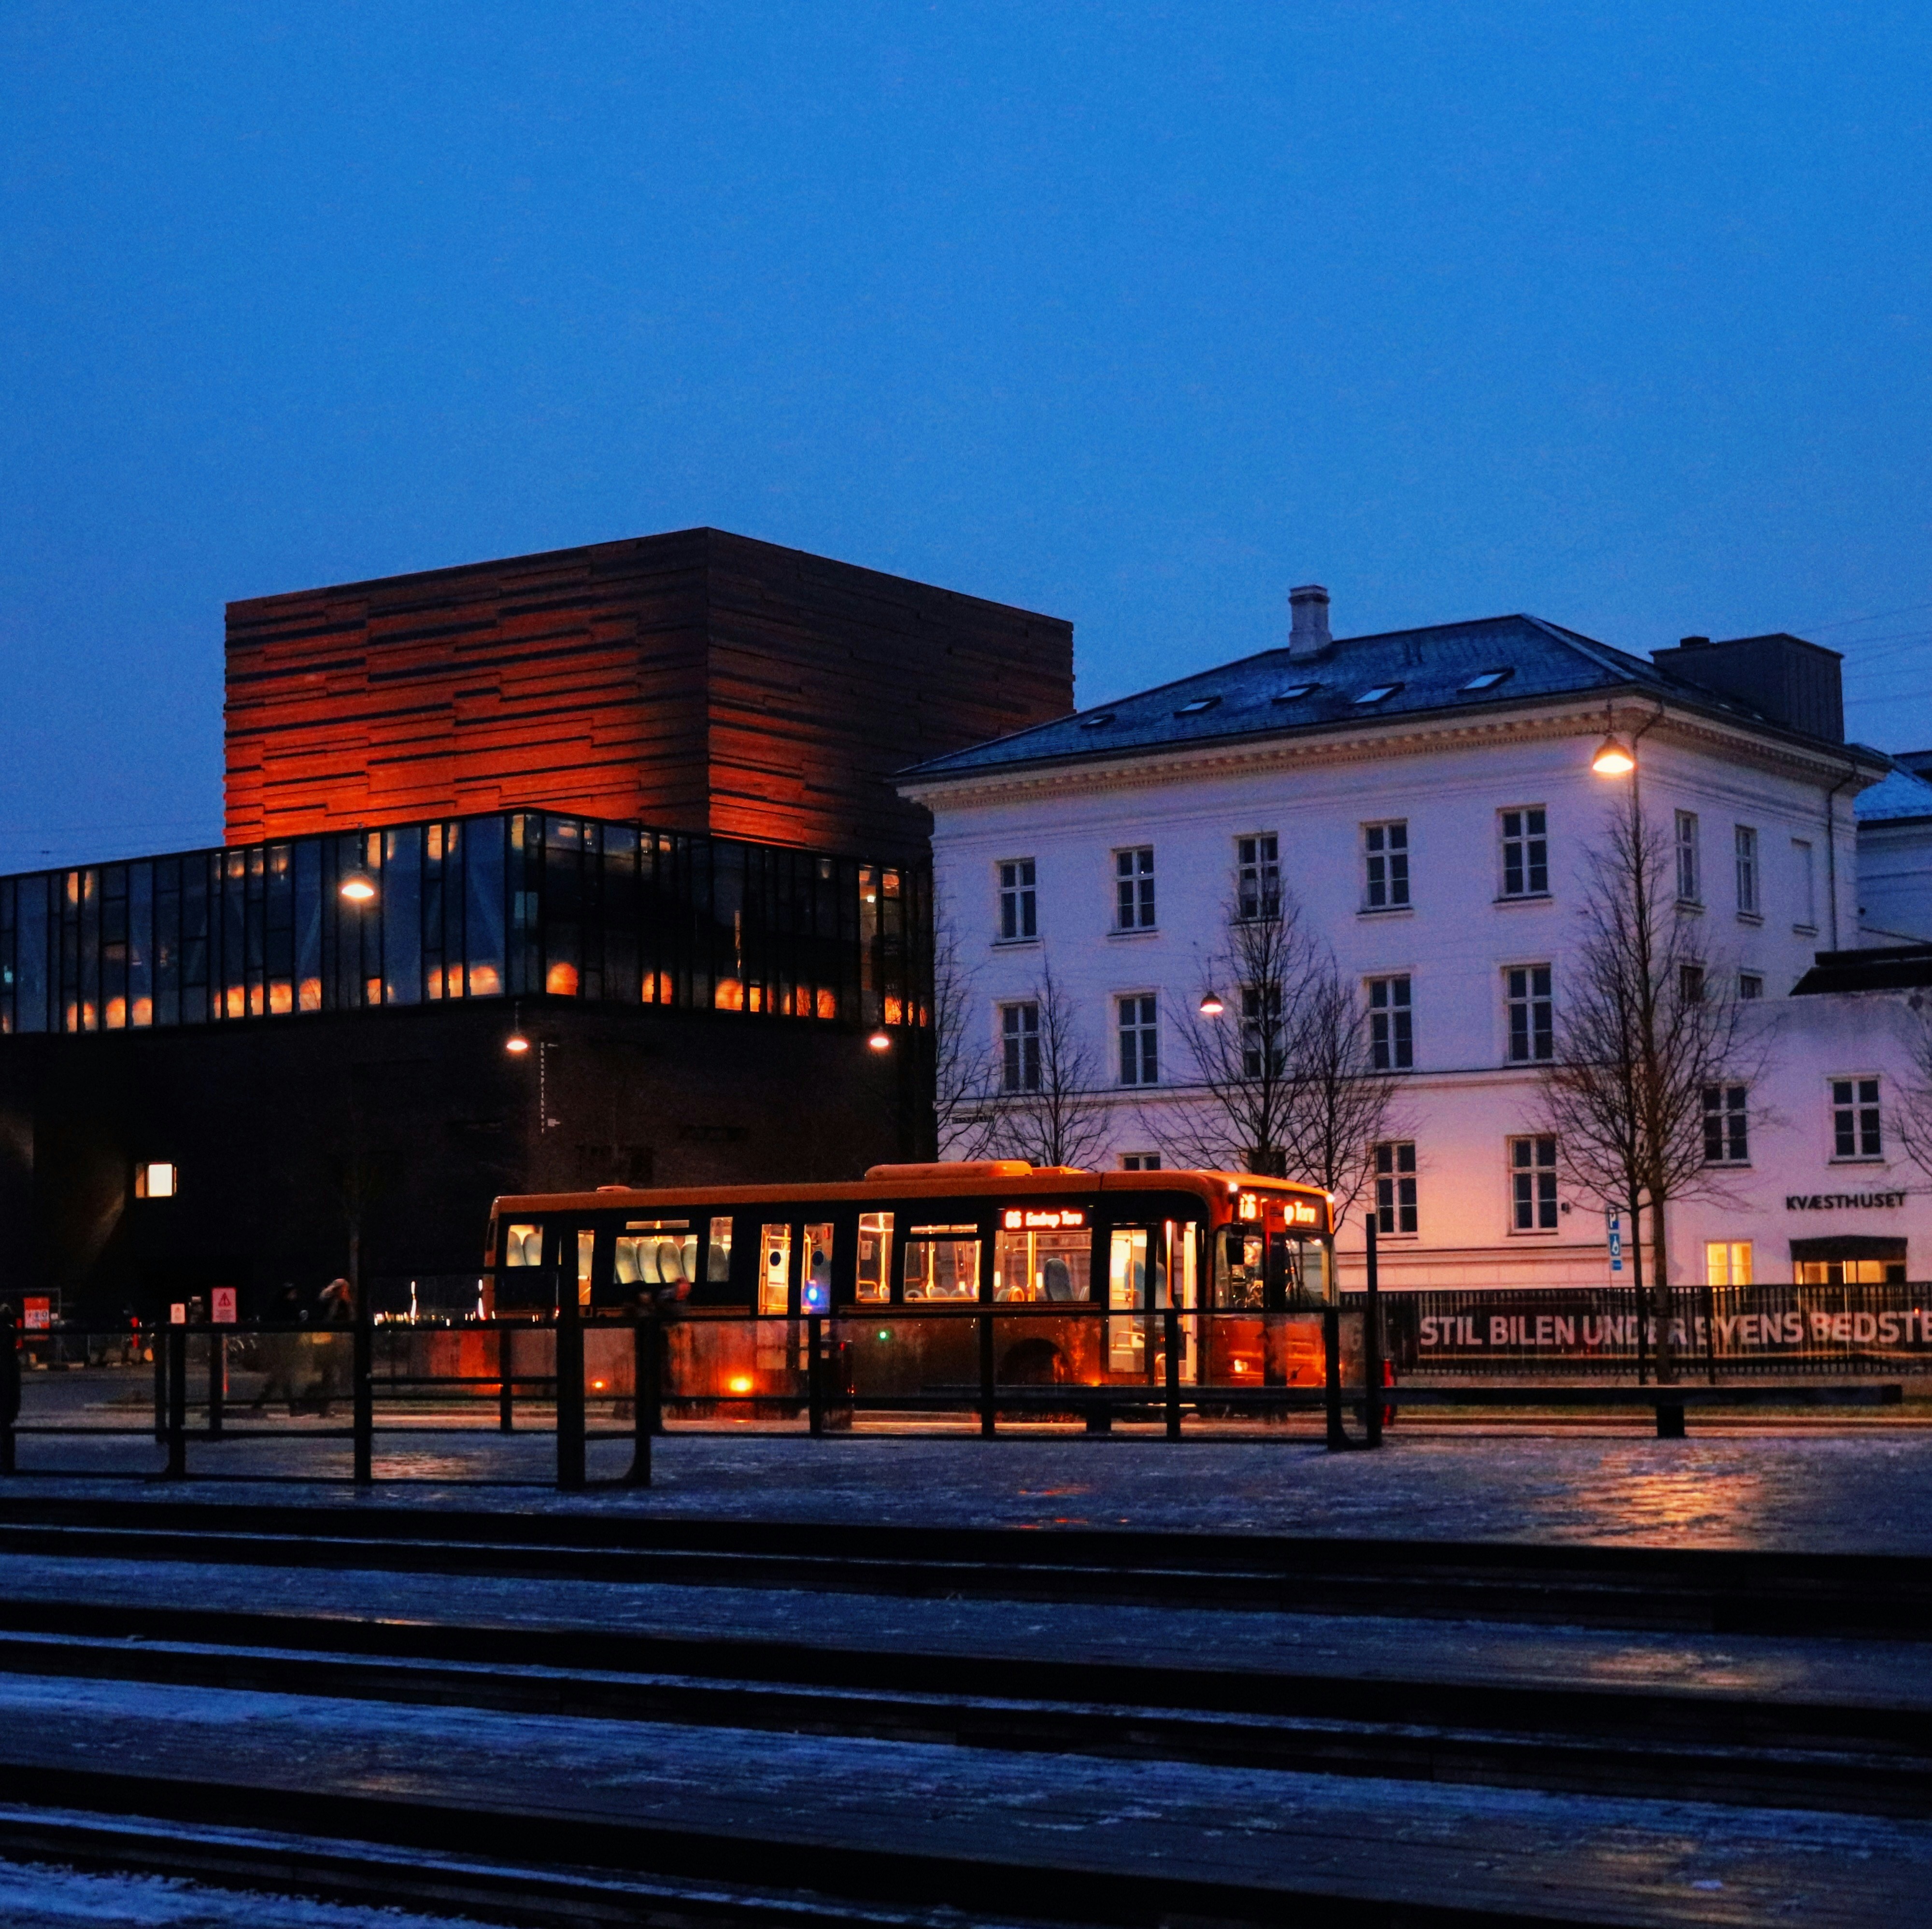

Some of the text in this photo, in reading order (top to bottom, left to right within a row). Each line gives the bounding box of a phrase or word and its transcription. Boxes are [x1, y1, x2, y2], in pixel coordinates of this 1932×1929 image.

[1786, 1191, 1907, 1209] KVÆSTHUSET
[1420, 1316, 1482, 1346] STIL
[1490, 1315, 1575, 1345] BILEN
